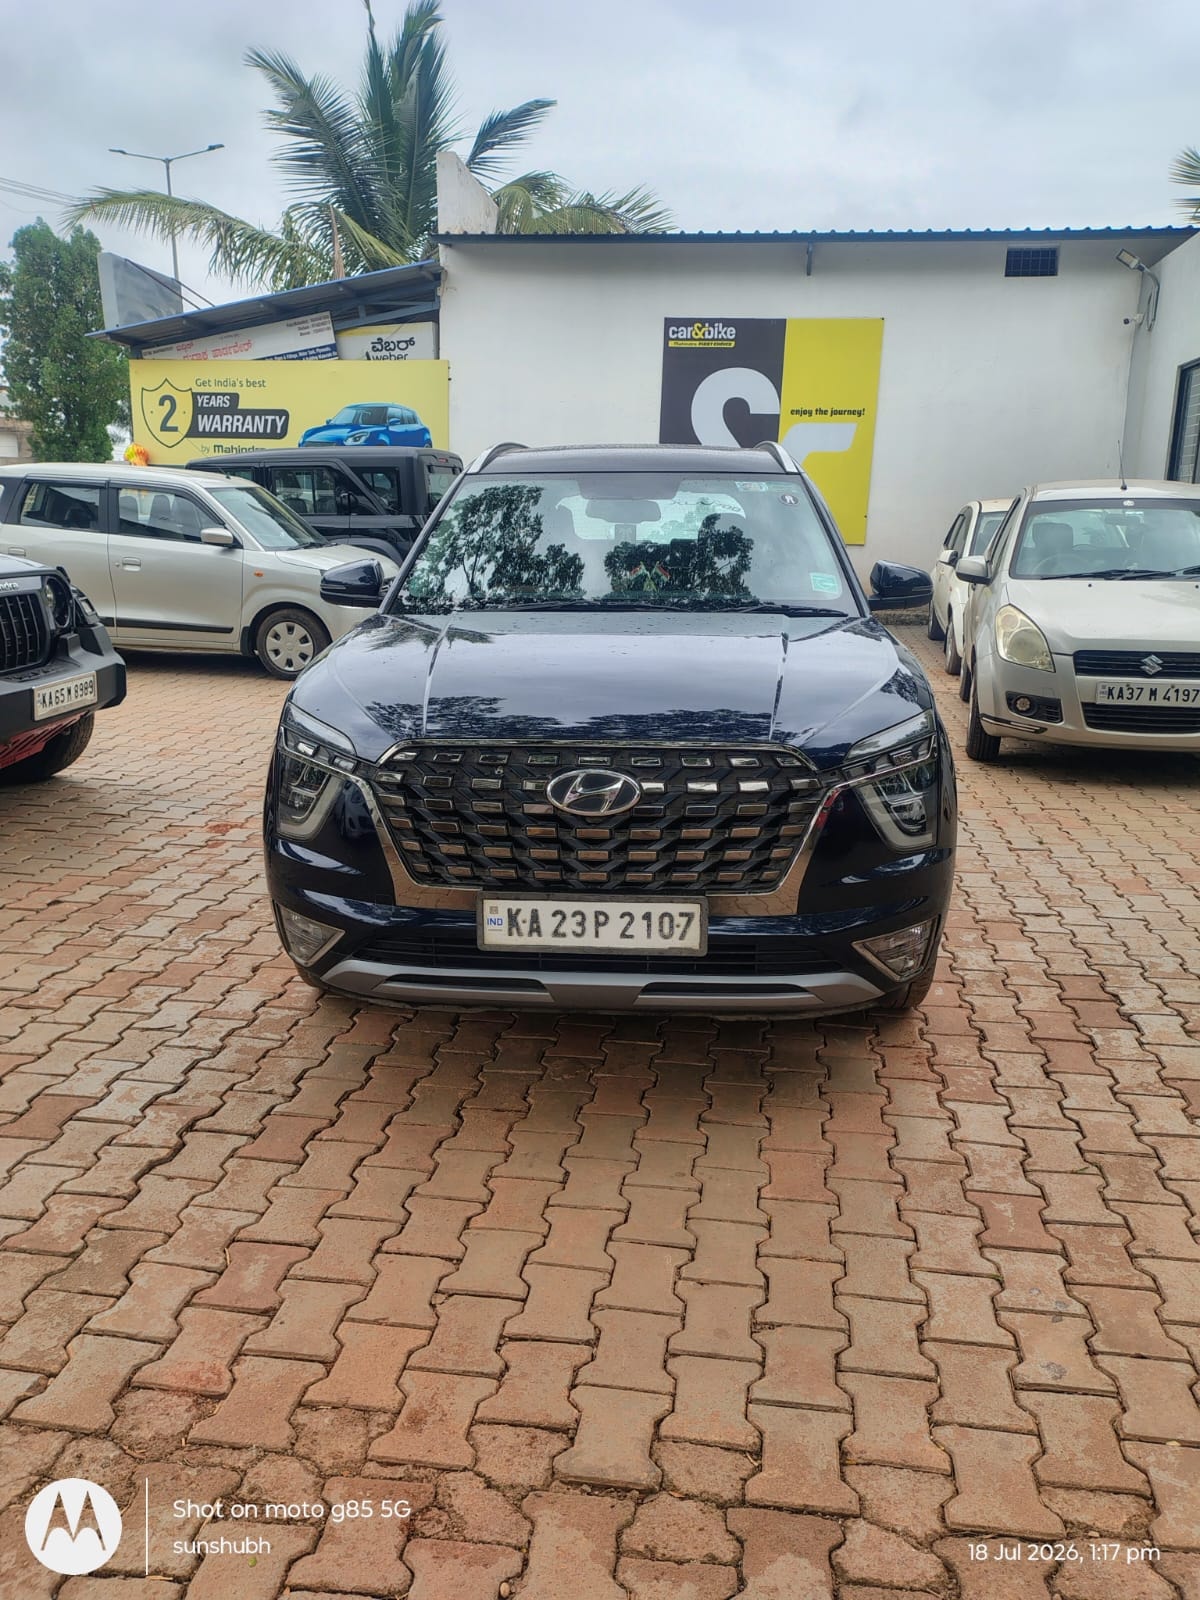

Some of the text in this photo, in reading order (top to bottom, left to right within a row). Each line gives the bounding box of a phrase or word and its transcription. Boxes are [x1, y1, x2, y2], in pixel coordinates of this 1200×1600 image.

[668, 322, 736, 339] car&bike
[371, 351, 409, 360] weber
[195, 378, 267, 388] Get India's best
[196, 394, 231, 408] YEARS
[158, 394, 179, 432] 2
[790, 407, 866, 417] enjoy the journey!
[197, 414, 287, 433] WARRANTY
[201, 443, 267, 454] by Mahind
[1162, 688, 1200, 703] 4197
[487, 917, 503, 927] IND
[618, 911, 695, 941] 2107
